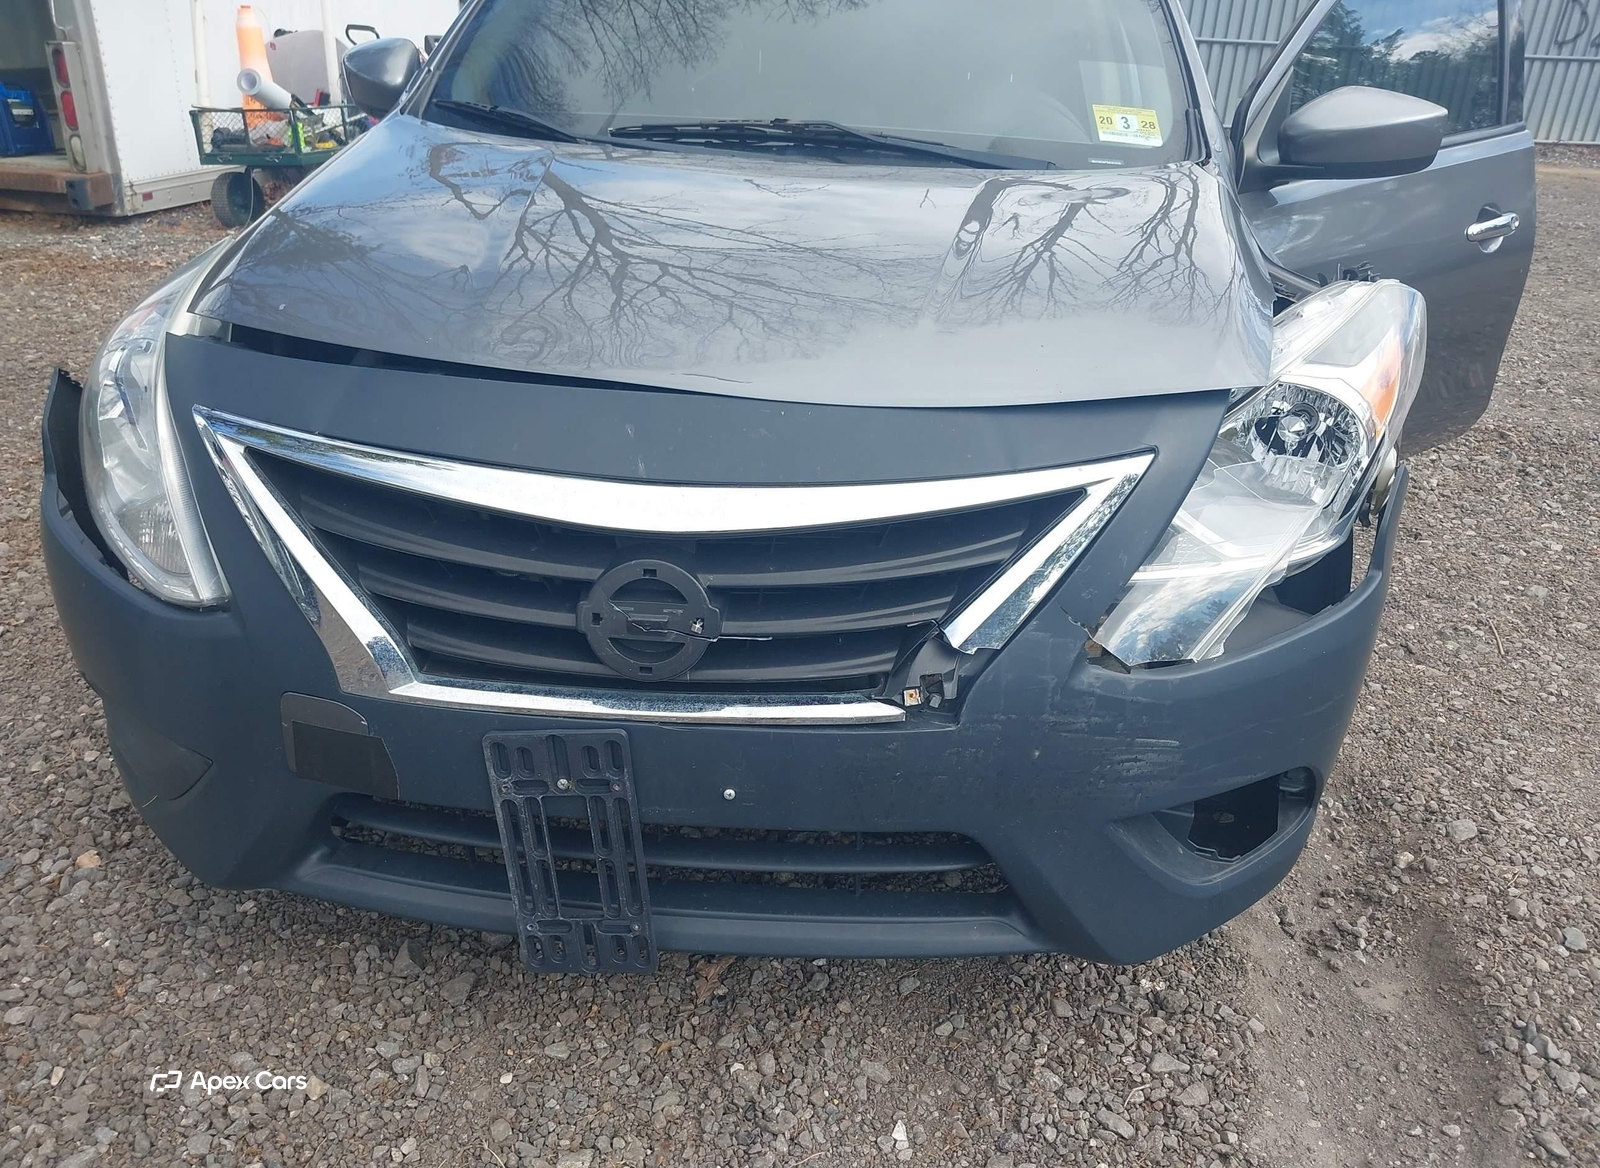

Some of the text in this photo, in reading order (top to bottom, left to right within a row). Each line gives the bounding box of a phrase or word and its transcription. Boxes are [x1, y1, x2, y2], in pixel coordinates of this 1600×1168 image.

[1099, 116, 1156, 130] 20 3 28
